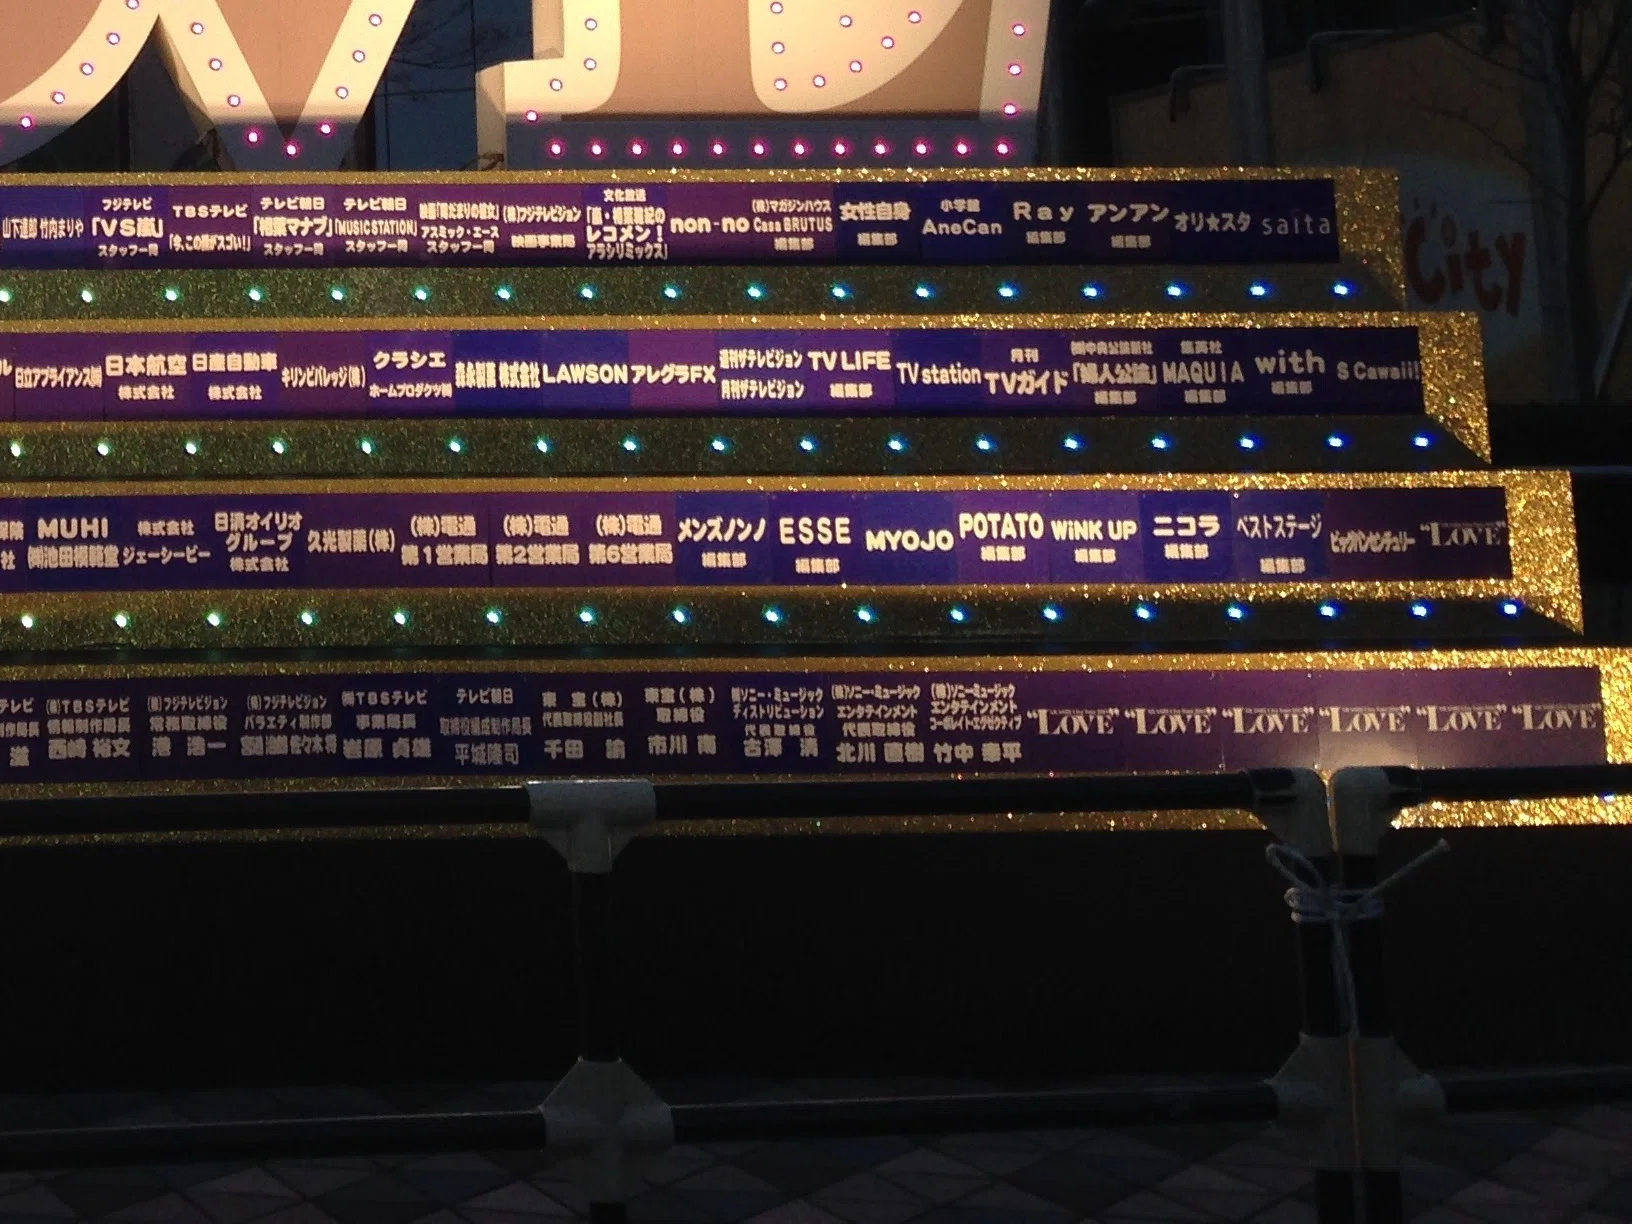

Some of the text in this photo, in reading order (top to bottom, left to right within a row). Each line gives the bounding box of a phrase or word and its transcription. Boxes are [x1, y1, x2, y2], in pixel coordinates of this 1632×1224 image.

[101, 196, 153, 212] フジテレビ
[172, 203, 249, 219] TBSテレビ
[259, 195, 325, 211] テレビ朝日
[343, 196, 407, 212] テレビ朝日
[838, 200, 912, 222] 女性自身
[1012, 201, 1074, 223] Ray
[1087, 203, 1170, 224] アンアン
[669, 216, 751, 234] non-no
[753, 216, 834, 233] Casa BRUTUS
[922, 218, 1003, 235] AneCan
[1261, 213, 1331, 236] saita
[1404, 215, 1526, 317] City
[105, 353, 188, 377] 日本航空
[191, 351, 278, 372] 日産自動車
[372, 350, 447, 370] クラシエ
[807, 350, 892, 372] TV LIFE
[1254, 348, 1326, 375] with
[1336, 360, 1350, 381] S
[542, 363, 629, 385] LAWSON
[630, 362, 717, 385] アレグラFX
[895, 361, 982, 385] TV station
[983, 368, 1069, 396] TVガイド
[1162, 360, 1245, 385] MAQUIA
[117, 384, 175, 401] 株式会社
[207, 384, 263, 401] 株式会社
[37, 516, 109, 540] MUHI
[137, 519, 195, 537] 株式会社
[214, 511, 303, 534] 日清オイリオ
[677, 515, 767, 543] メンズノンノ
[779, 516, 852, 545] ESSE
[958, 511, 1045, 540] POTATO
[1107, 519, 1138, 541] UP
[1152, 514, 1221, 538] ニコラ
[1236, 512, 1322, 539] ベストステージ
[225, 530, 294, 553] グループ
[865, 529, 955, 552] MYOJO
[122, 544, 211, 566] ジェーシービー
[229, 555, 290, 573] 株式会社
